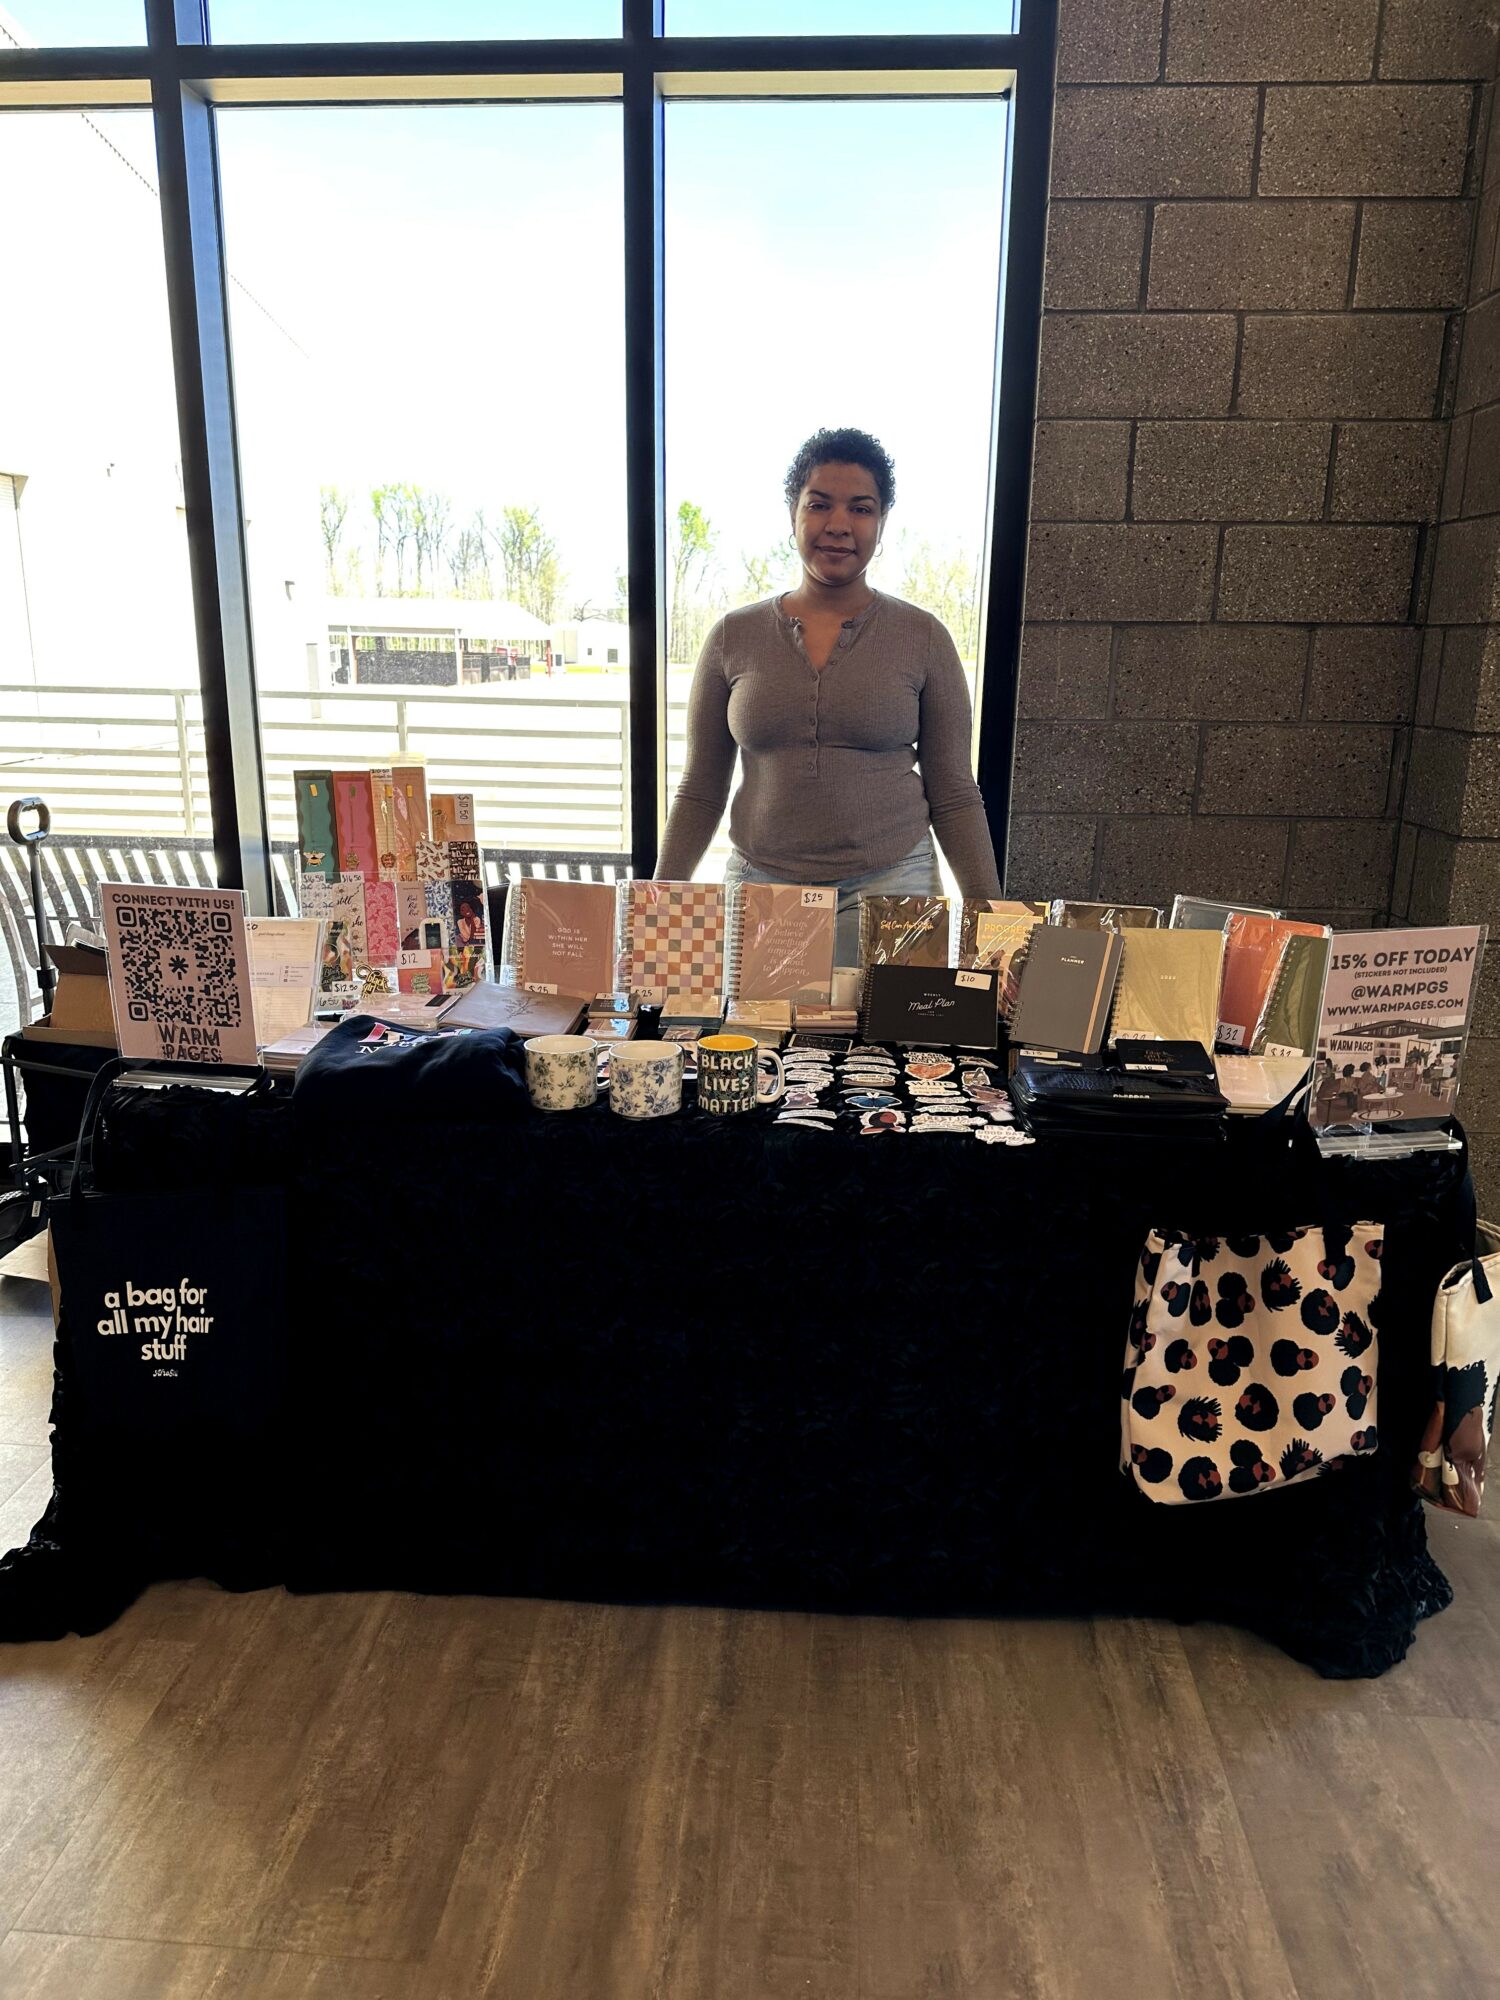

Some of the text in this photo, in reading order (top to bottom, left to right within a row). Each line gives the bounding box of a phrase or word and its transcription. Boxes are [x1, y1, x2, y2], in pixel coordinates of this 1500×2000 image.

[111, 893, 235, 909] CONNECT WITH US!
[804, 892, 823, 904] $25
[547, 934, 573, 942] WITHIN
[400, 952, 419, 965] $12
[1330, 946, 1476, 971] 15% OFF TODAY
[961, 974, 975, 983] $10
[1354, 966, 1448, 979] (STICKERS NOT INCLUDED)
[334, 983, 348, 993] $12
[1350, 980, 1449, 1000] @WARMPGS
[907, 998, 956, 1012] Meal Plan
[1327, 998, 1464, 1017] WWW.WARMPAGES.COM
[157, 1023, 221, 1047] WARM
[164, 1043, 221, 1063] PAGES
[1330, 1039, 1373, 1051] WARM PAGES
[701, 1054, 753, 1071] BLACK
[704, 1076, 750, 1092] LIVES
[698, 1094, 756, 1113] MATTER
[104, 1277, 208, 1312] a bag for
[97, 1305, 214, 1340] all my hair
[141, 1333, 187, 1361] stuff
